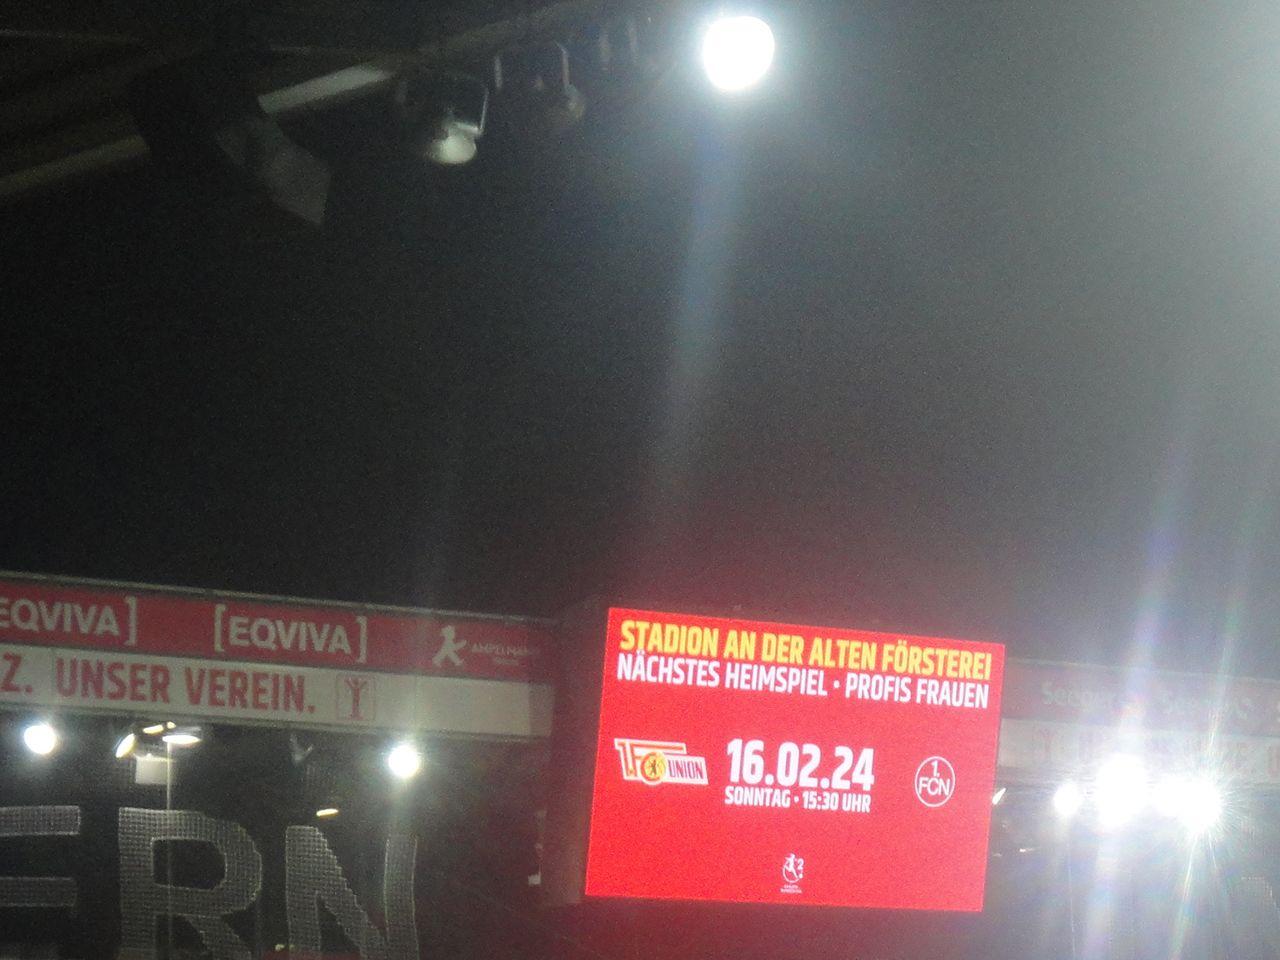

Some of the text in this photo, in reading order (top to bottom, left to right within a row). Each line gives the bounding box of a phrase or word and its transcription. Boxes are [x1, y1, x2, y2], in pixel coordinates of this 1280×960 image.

[620, 620, 992, 681] STADION AN DER ALTEN FÖRSTEREI
[55, 657, 170, 704] UNSER
[186, 668, 316, 715] VEREIN.
[617, 650, 989, 710] NÄCHSTES HEIMSPIEL PROFIS FRAUEN
[667, 758, 705, 780] UNION
[726, 738, 875, 791] 16.02.24
[919, 776, 951, 796] FCN
[724, 785, 871, 813] SONNTAG 15:30 UHR
